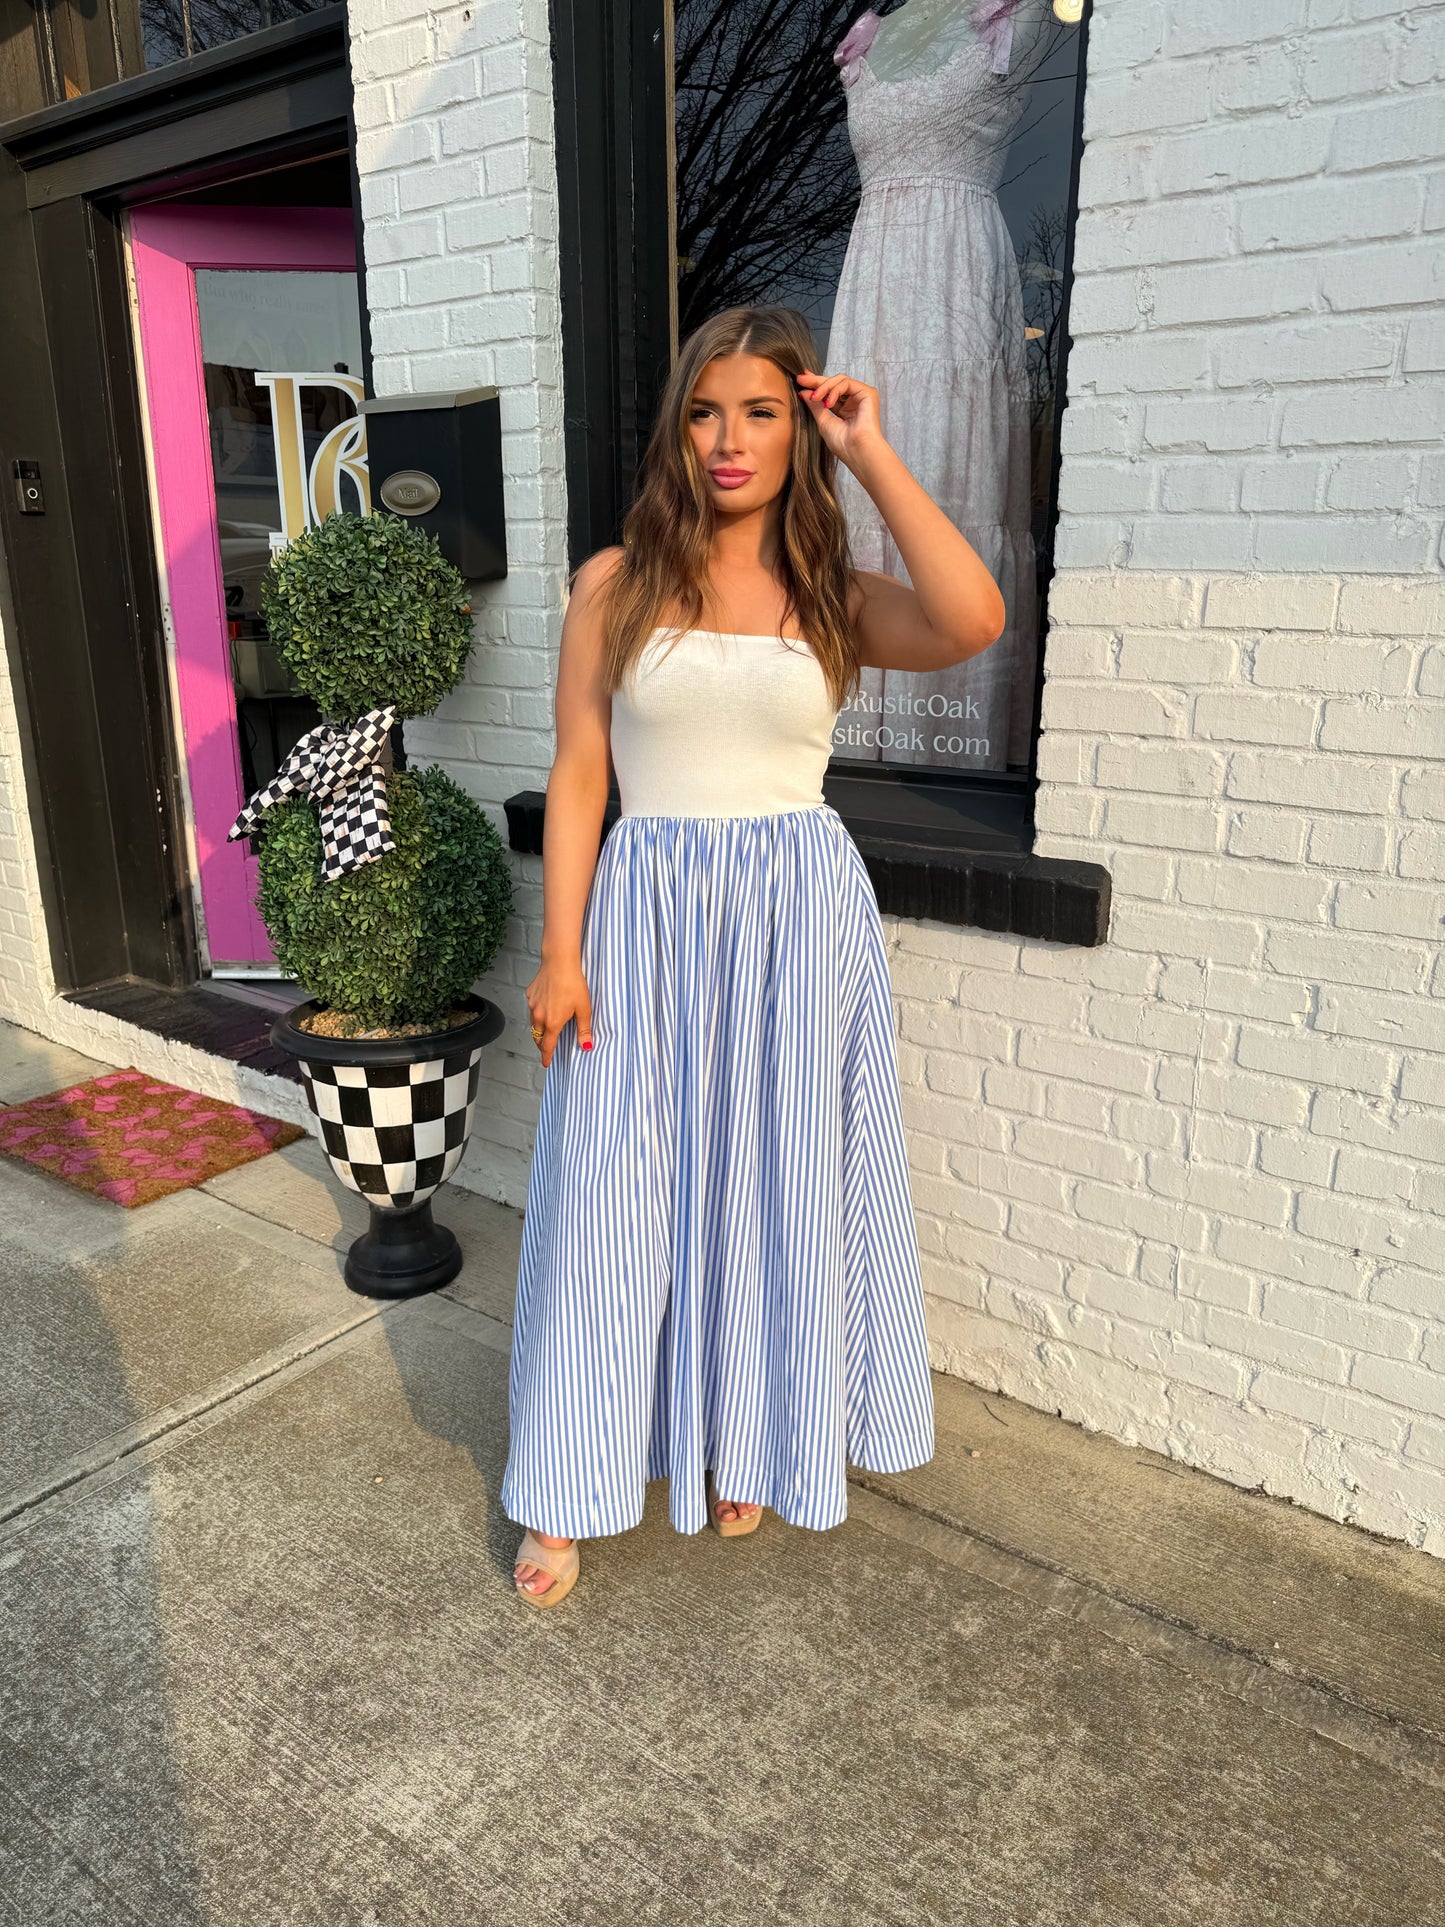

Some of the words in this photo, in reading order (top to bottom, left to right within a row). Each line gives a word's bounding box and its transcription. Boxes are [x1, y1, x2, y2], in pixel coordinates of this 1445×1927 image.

[398, 486, 419, 500] Mail
[829, 723, 926, 751] sticOak
[933, 734, 991, 757] com
